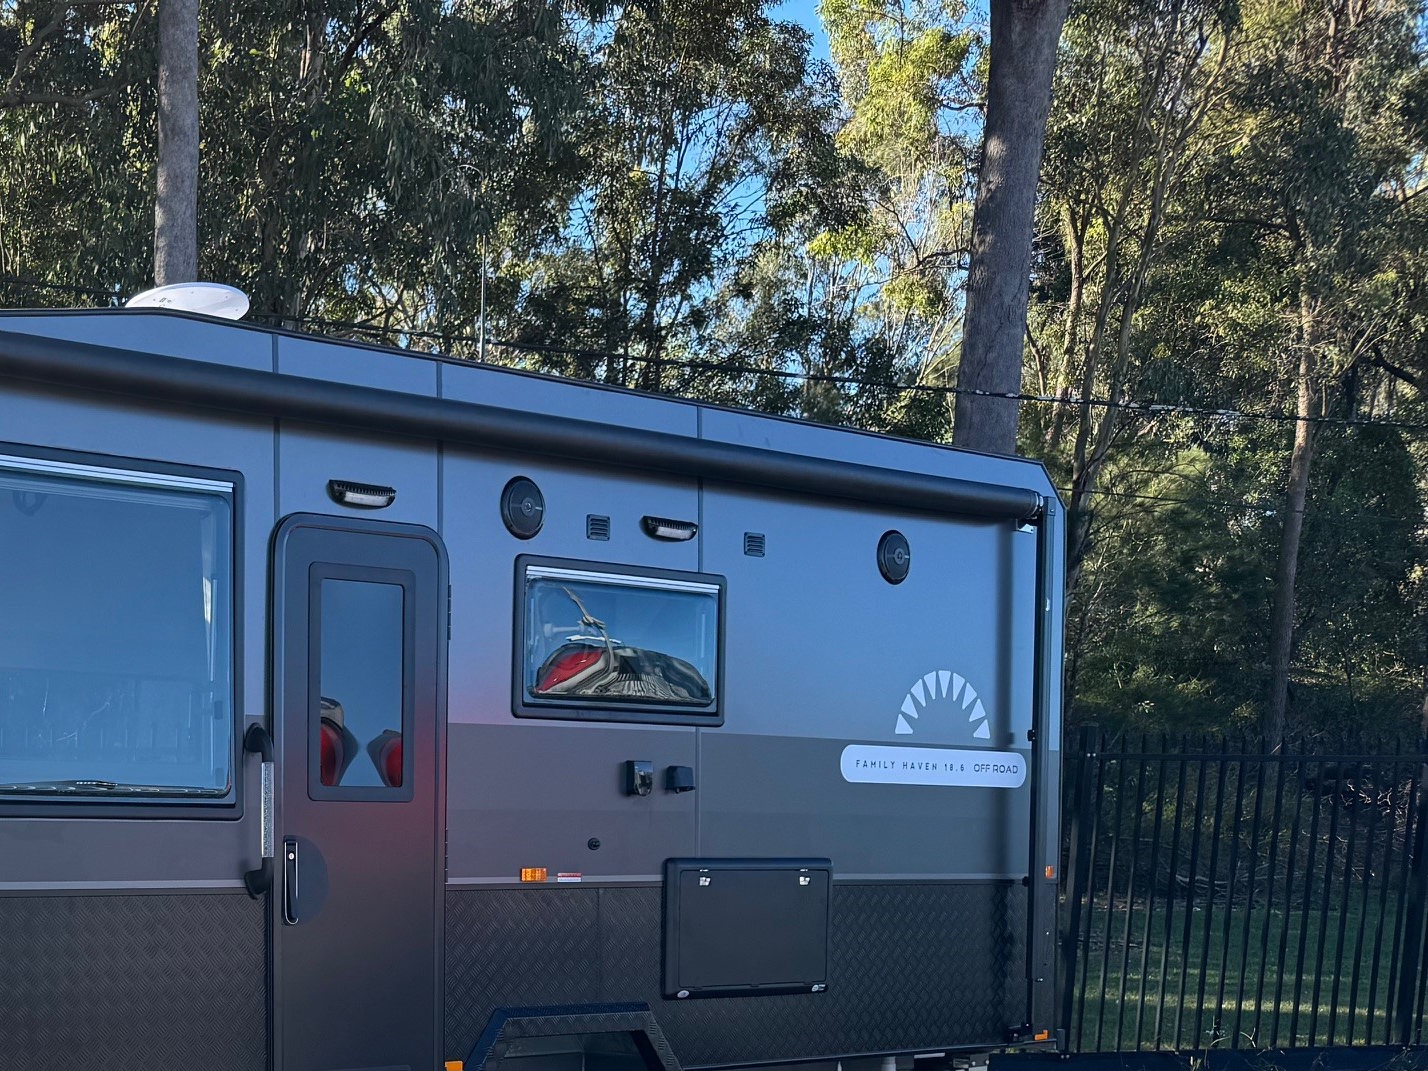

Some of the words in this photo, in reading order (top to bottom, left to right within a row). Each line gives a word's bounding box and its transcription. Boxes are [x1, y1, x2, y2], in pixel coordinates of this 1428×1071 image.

[855, 759, 896, 770] FAMILY
[902, 761, 938, 771] HAVEN
[944, 763, 965, 772] 18.6
[973, 763, 991, 773] OFF
[992, 764, 1019, 774] ROAD
